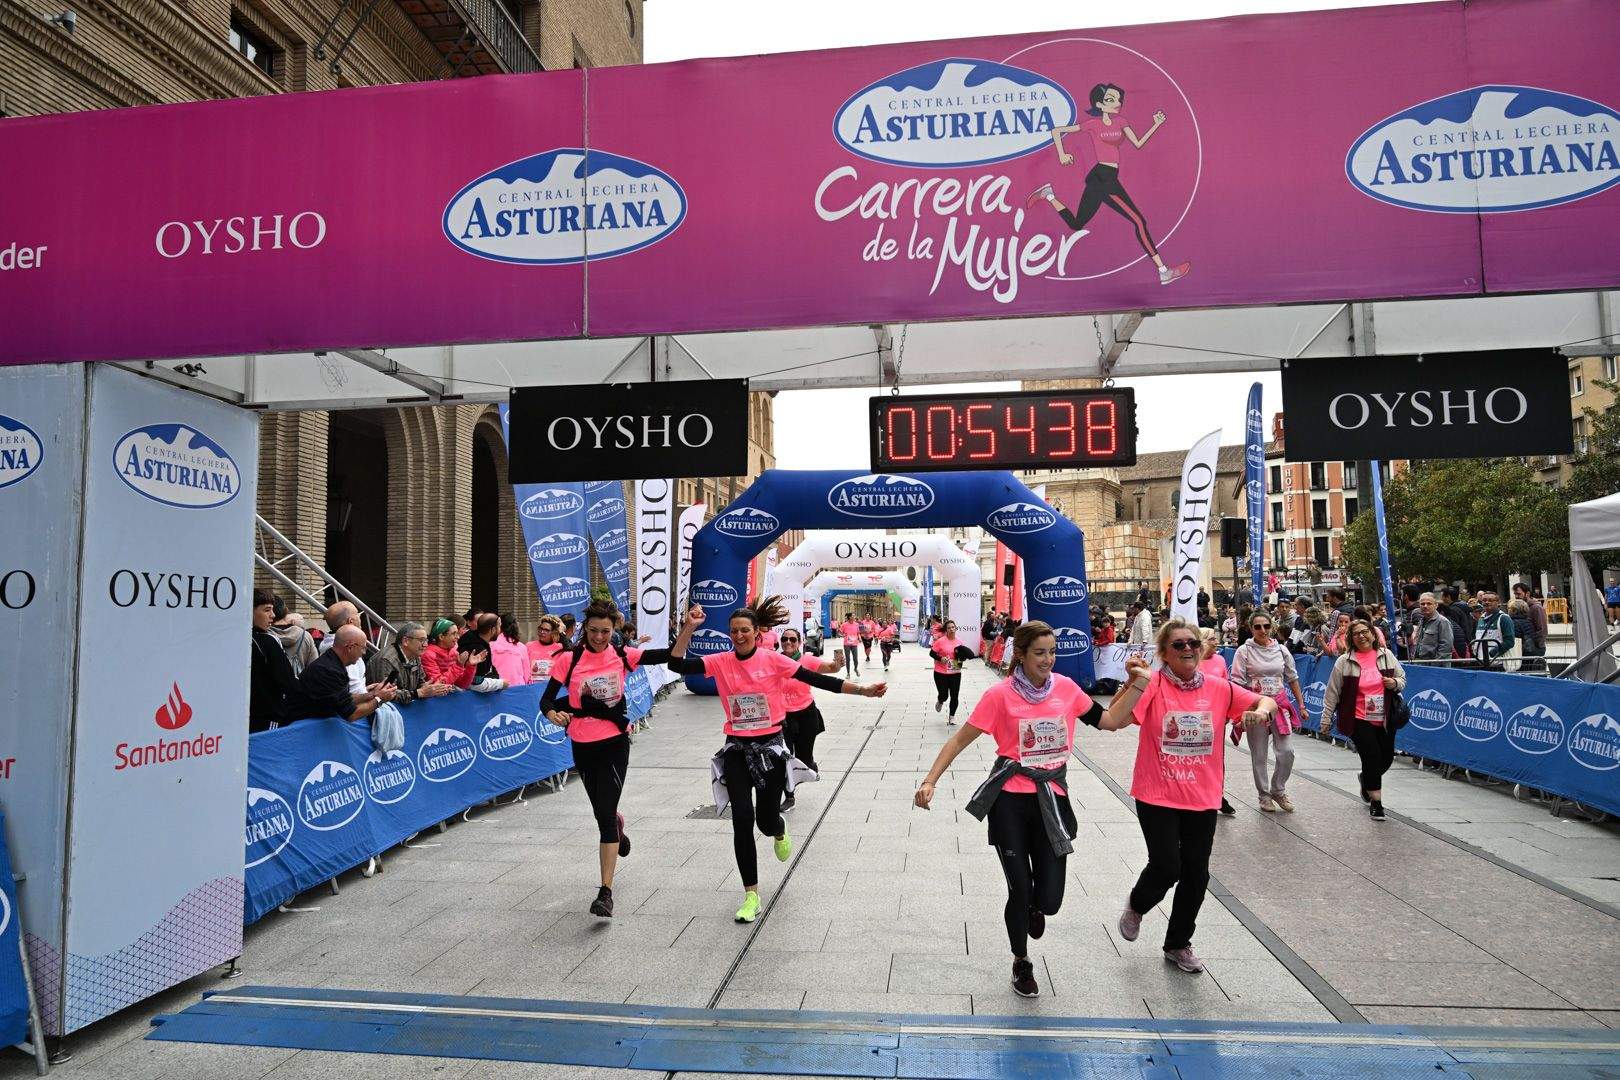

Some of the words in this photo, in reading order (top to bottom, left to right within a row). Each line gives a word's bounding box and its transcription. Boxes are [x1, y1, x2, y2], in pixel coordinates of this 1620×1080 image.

[888, 96, 964, 111] CENTRAL
[971, 91, 1049, 106] LECHERA
[851, 103, 1057, 145] ASTURIANA
[1413, 129, 1504, 147] CENTRAL
[1515, 122, 1610, 139] LECHERA
[1369, 139, 1620, 186] ASTURIANA
[498, 188, 573, 204] CENTRAL
[580, 182, 660, 199] LECHERA
[814, 165, 1014, 222] Carrera
[460, 198, 668, 240] ASTURIANA
[155, 211, 327, 259] OYSHO
[863, 222, 899, 262] de
[907, 219, 934, 261] la
[928, 207, 1091, 304] Mujer
[1328, 386, 1528, 430] OYSHO
[546, 413, 714, 451] OYSHO
[122, 443, 233, 495] ASTURIANA
[145, 444, 187, 462] CENTRAL
[191, 455, 230, 471] LECHERA
[835, 487, 927, 507] ASTURIANA
[1285, 468, 1294, 513] HOTEL
[718, 518, 774, 531] ASTURIANA
[993, 515, 1052, 527] ASTURIANA
[1176, 462, 1213, 605] OYSHO
[835, 540, 917, 559] OYSHO
[109, 568, 238, 610] OYSHO
[1037, 588, 1084, 599] ASTURIANA
[1410, 701, 1447, 723] ASTURIANA
[1456, 707, 1498, 733] ASTURIANA
[485, 730, 530, 754] ASTURIANA
[1036, 735, 1055, 744] 016
[1508, 718, 1559, 745] ASTURIANA
[115, 733, 223, 771] Santander
[423, 746, 474, 775] ASTURIANA
[1159, 752, 1207, 766] DORSAL
[367, 766, 413, 795] ASTURIANA
[1161, 766, 1196, 781] SUMA
[304, 783, 363, 822] ASTURIANA
